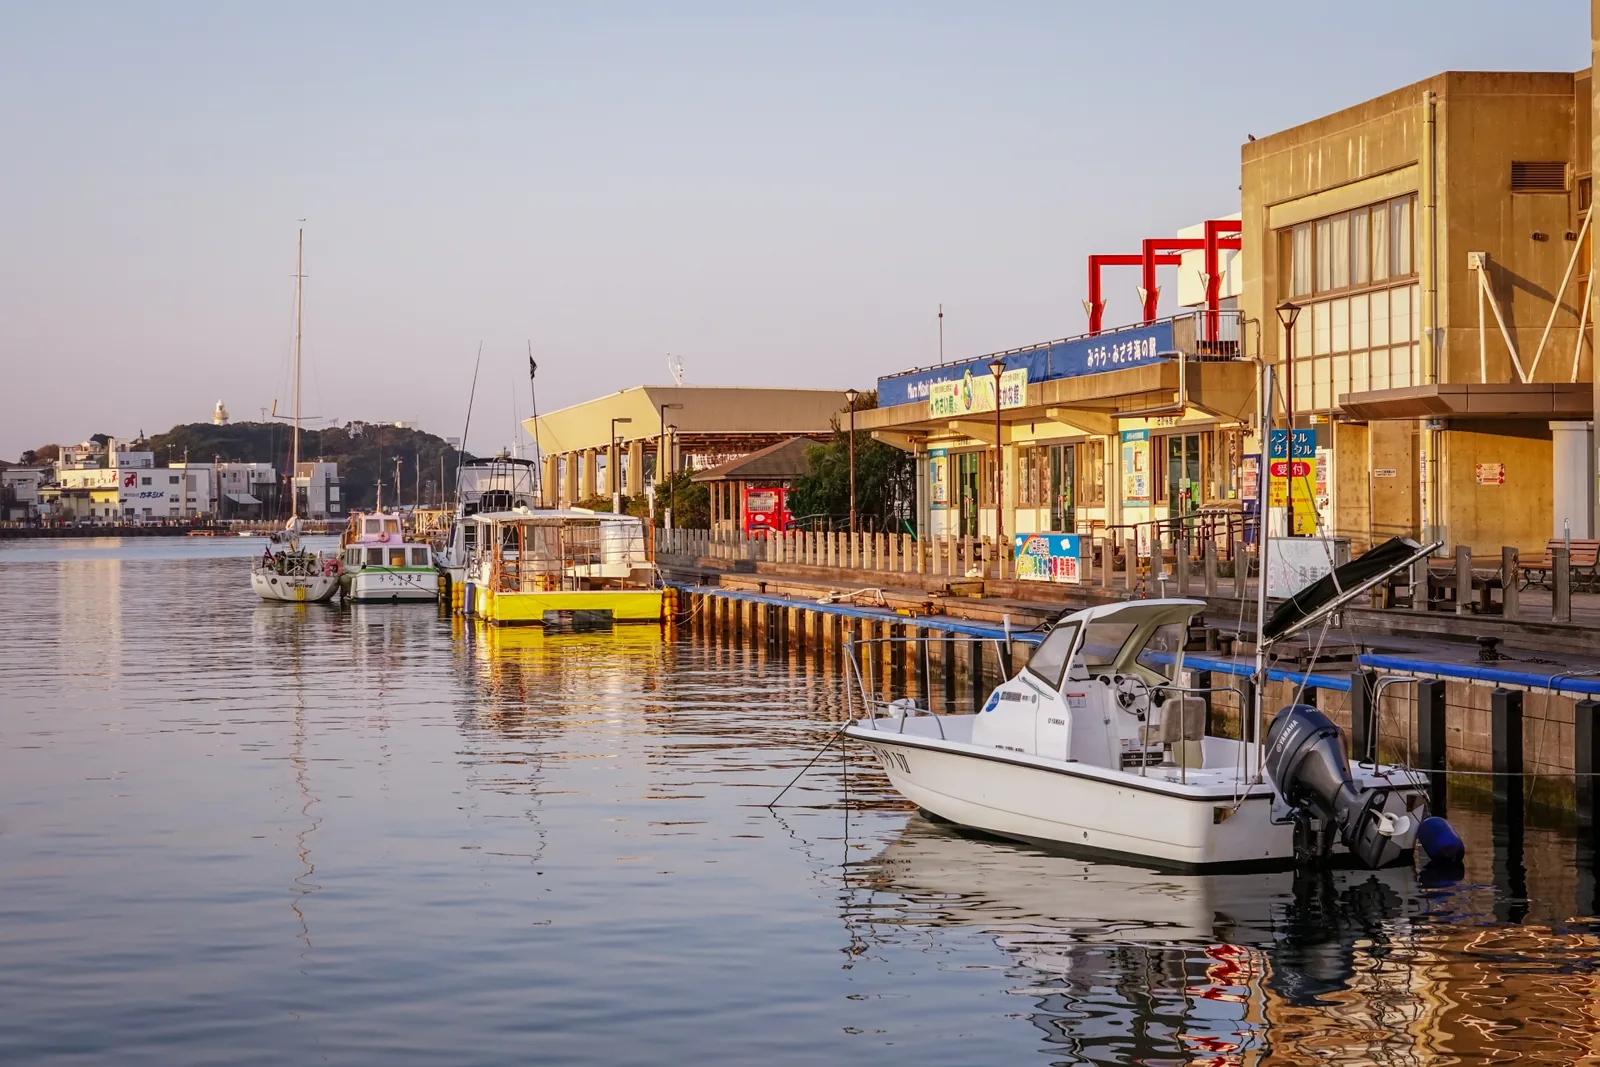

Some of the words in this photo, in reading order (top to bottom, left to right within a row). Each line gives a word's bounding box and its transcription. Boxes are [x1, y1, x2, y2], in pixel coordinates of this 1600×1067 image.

[1277, 463, 1304, 476] 受付
[140, 491, 165, 499] カネシメ
[1279, 720, 1299, 745] YAMAHA
